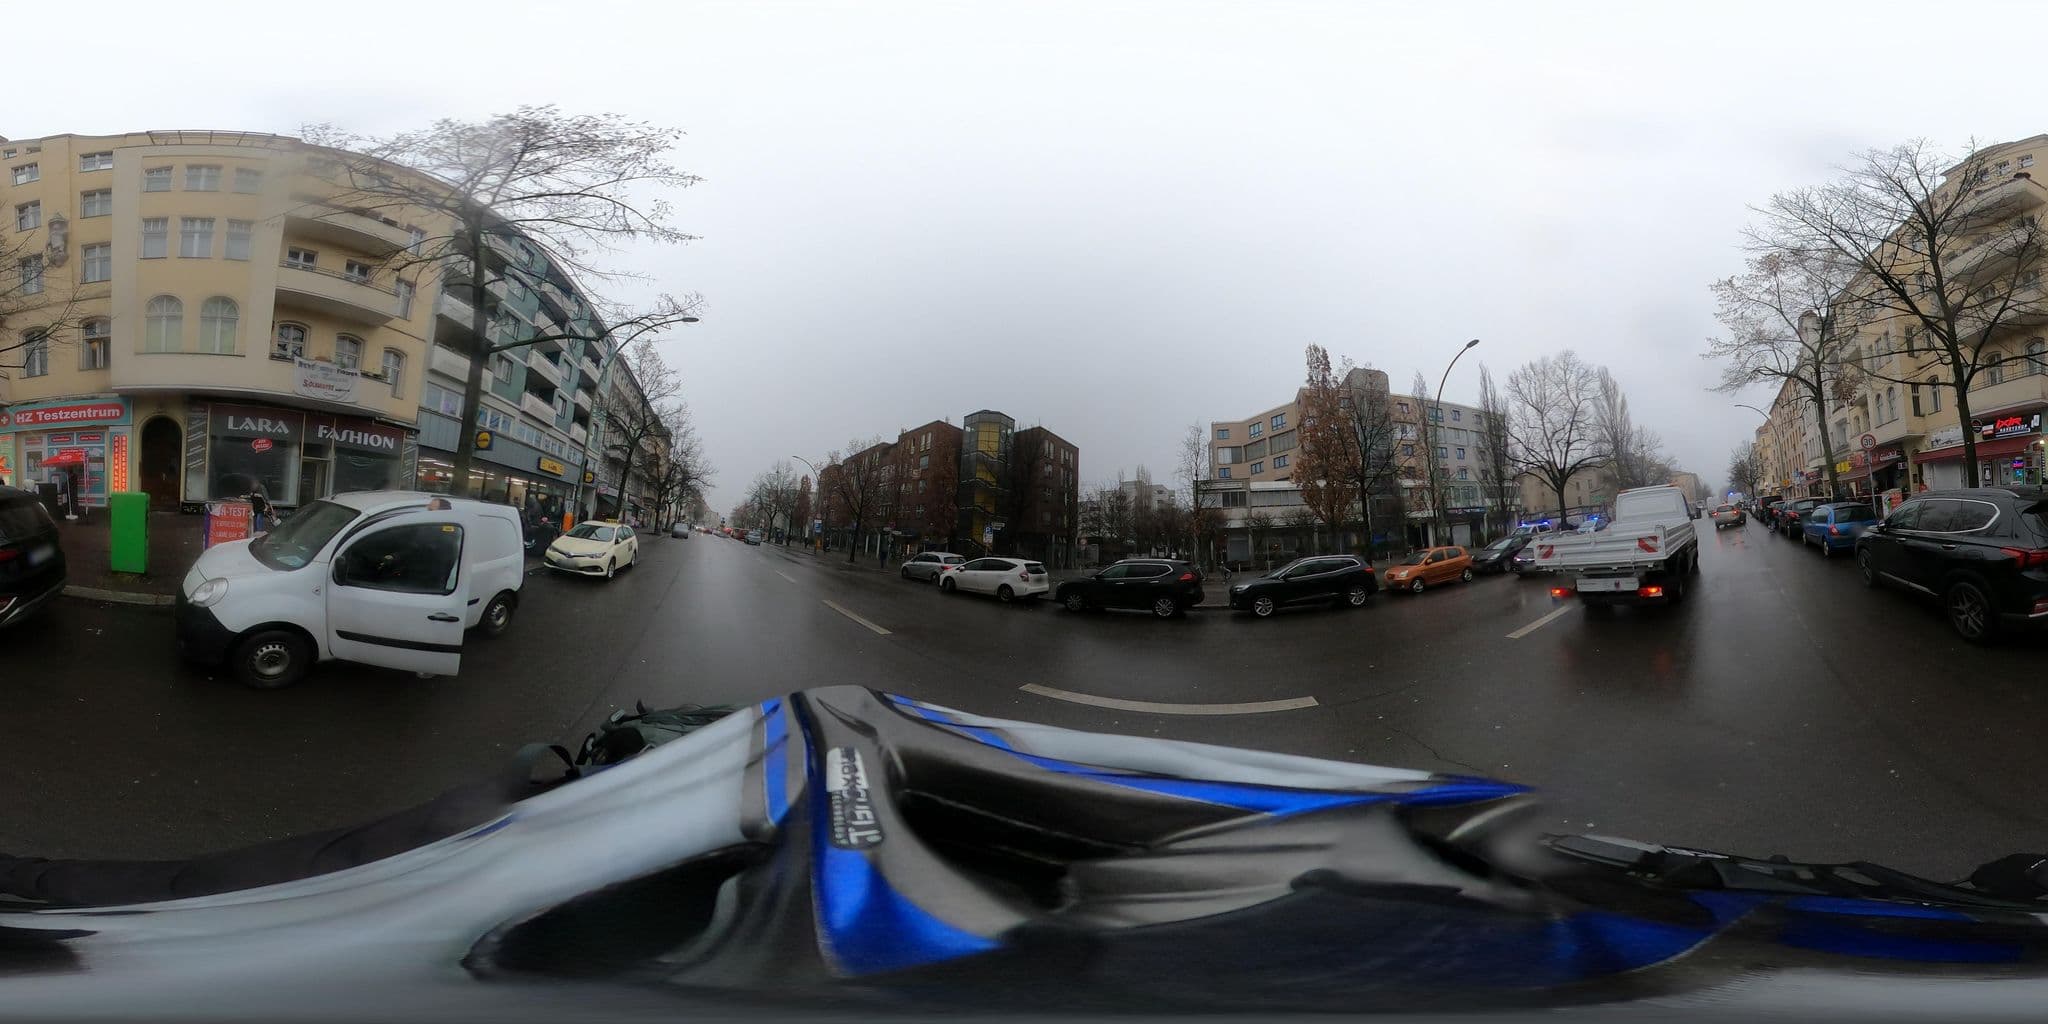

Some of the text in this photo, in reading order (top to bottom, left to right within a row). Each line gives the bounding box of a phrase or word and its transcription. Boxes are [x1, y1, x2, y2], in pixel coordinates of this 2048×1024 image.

[16, 407, 120, 423] HZ Testzentrum
[228, 416, 394, 449] LARA FASHION
[1864, 438, 1873, 446] 30
